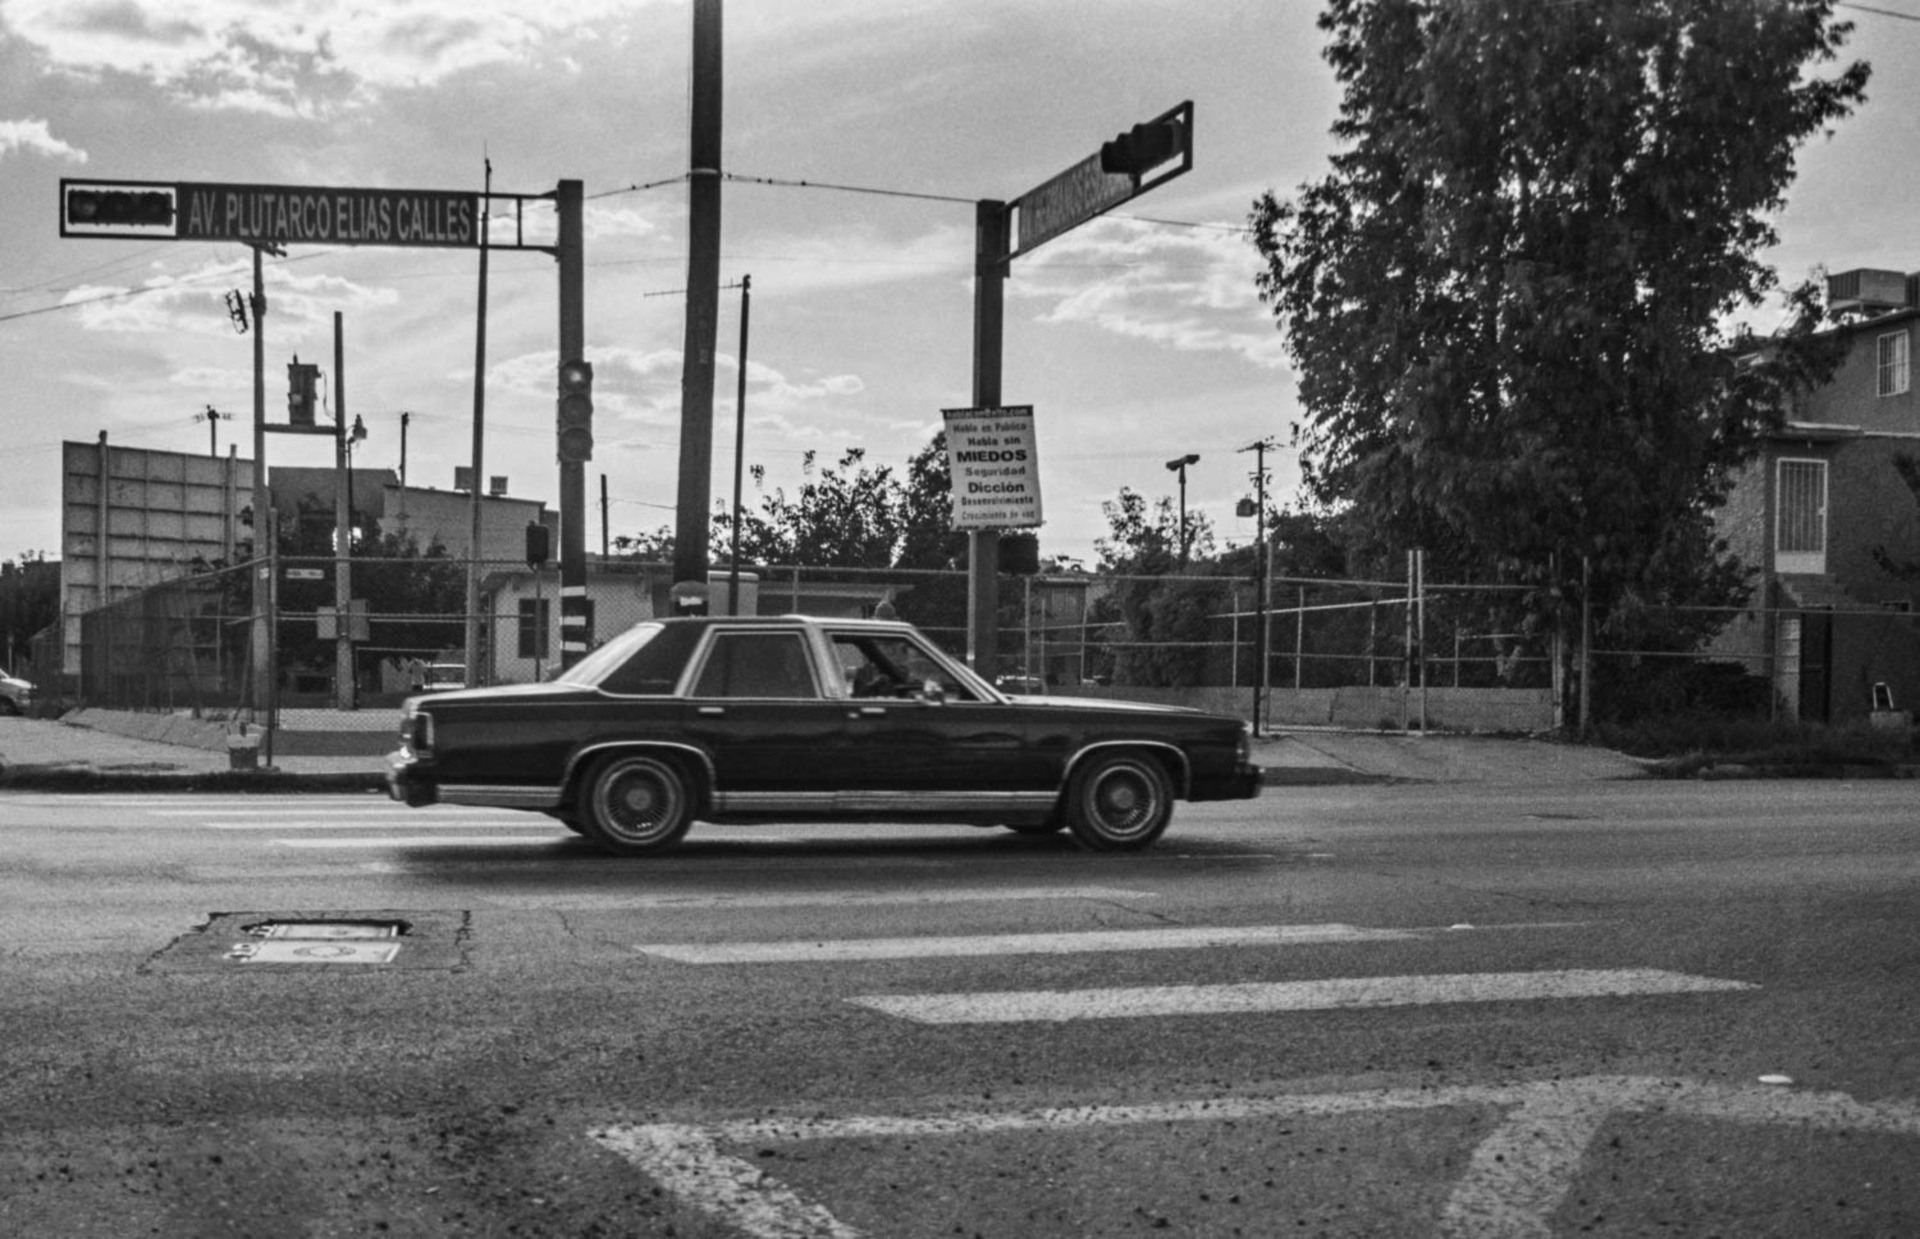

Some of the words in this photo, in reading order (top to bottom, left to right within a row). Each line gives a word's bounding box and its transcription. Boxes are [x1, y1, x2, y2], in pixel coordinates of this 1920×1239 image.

[188, 191, 219, 236] AV.
[225, 193, 330, 239] PLUTARCO
[336, 196, 391, 240] ELIAS
[397, 197, 470, 242] CALLES
[953, 423, 977, 432] Habla
[968, 436, 998, 446] Habla
[1004, 436, 1021, 445] sin
[956, 449, 1027, 462] MIEDOS
[965, 466, 1025, 477] Seguridad
[968, 481, 1025, 493] Dicción
